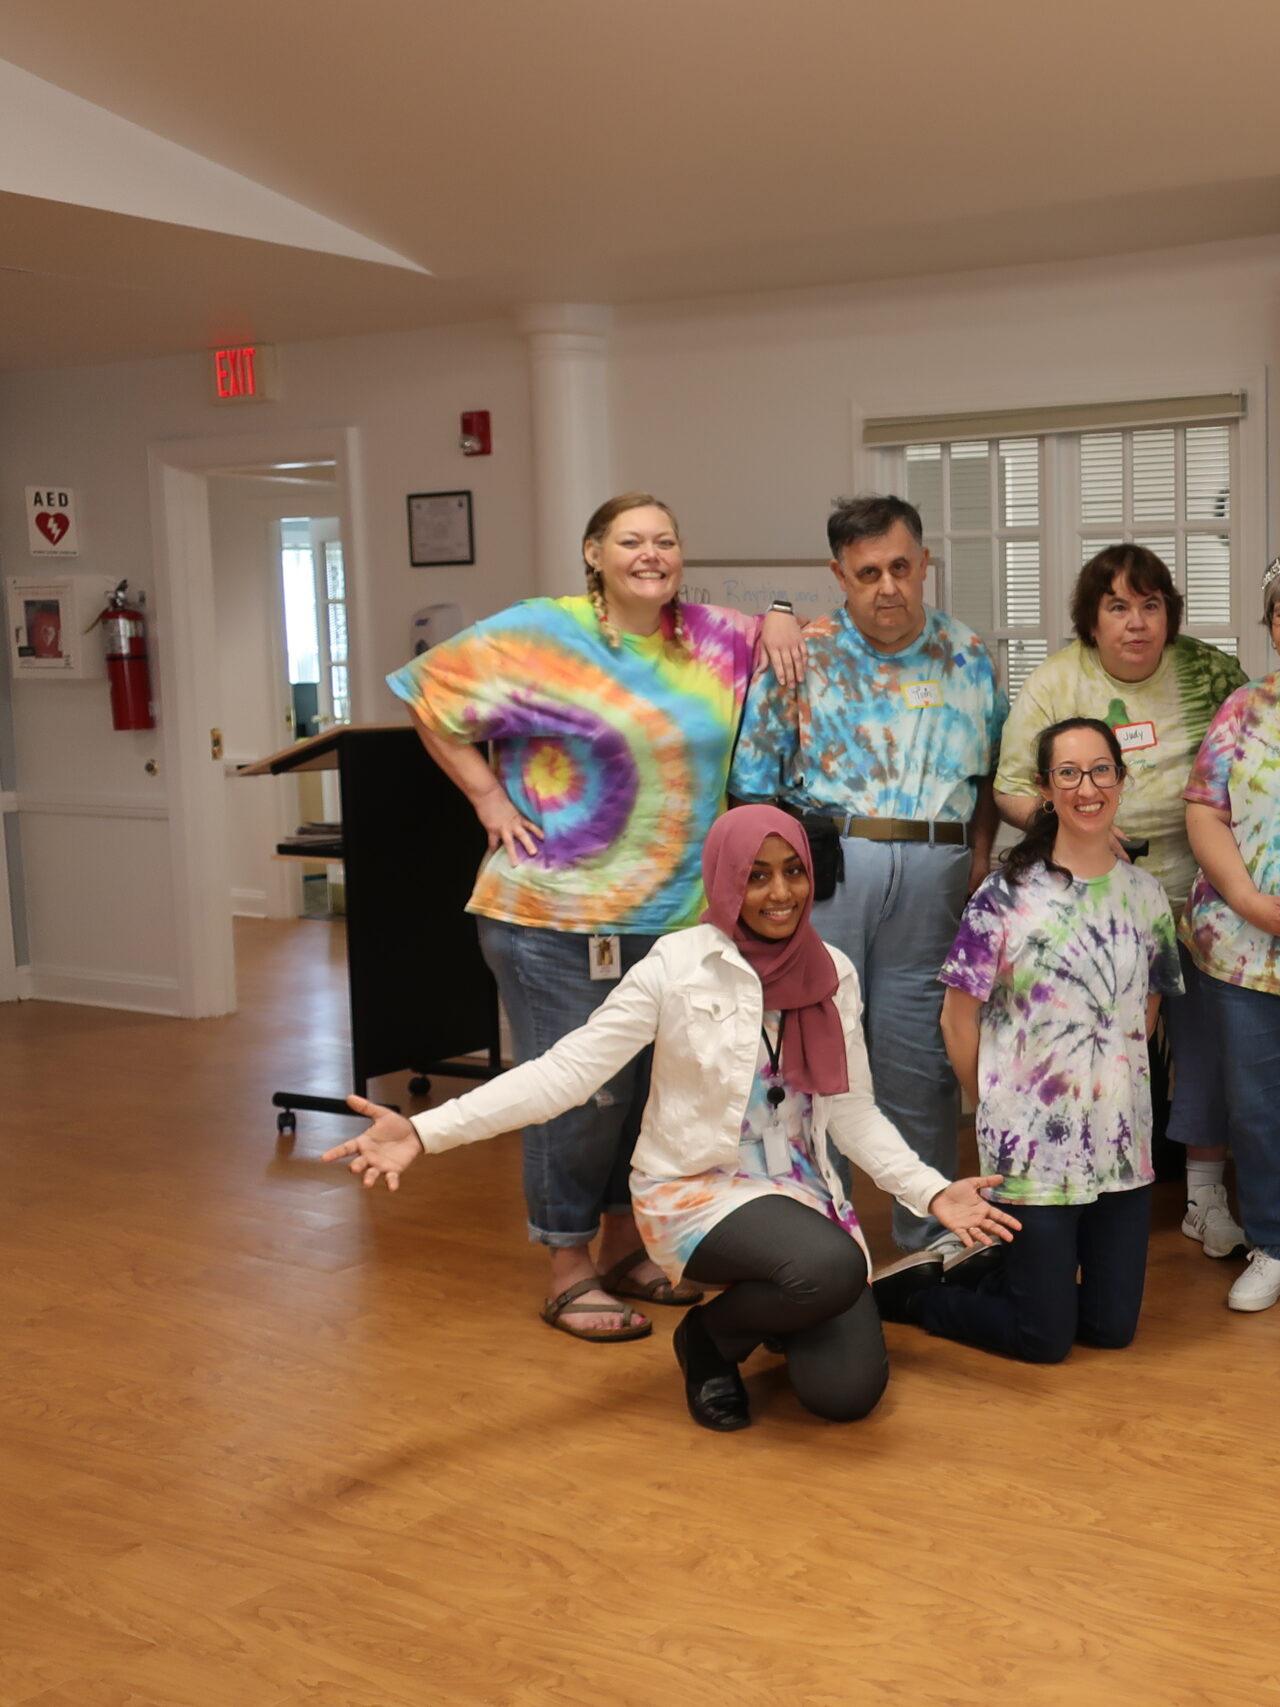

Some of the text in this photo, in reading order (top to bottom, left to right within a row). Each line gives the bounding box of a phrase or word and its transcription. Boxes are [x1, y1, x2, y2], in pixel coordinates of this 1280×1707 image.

[215, 347, 256, 398] EXIT
[33, 490, 69, 508] AED
[1122, 728, 1144, 742] Judy
